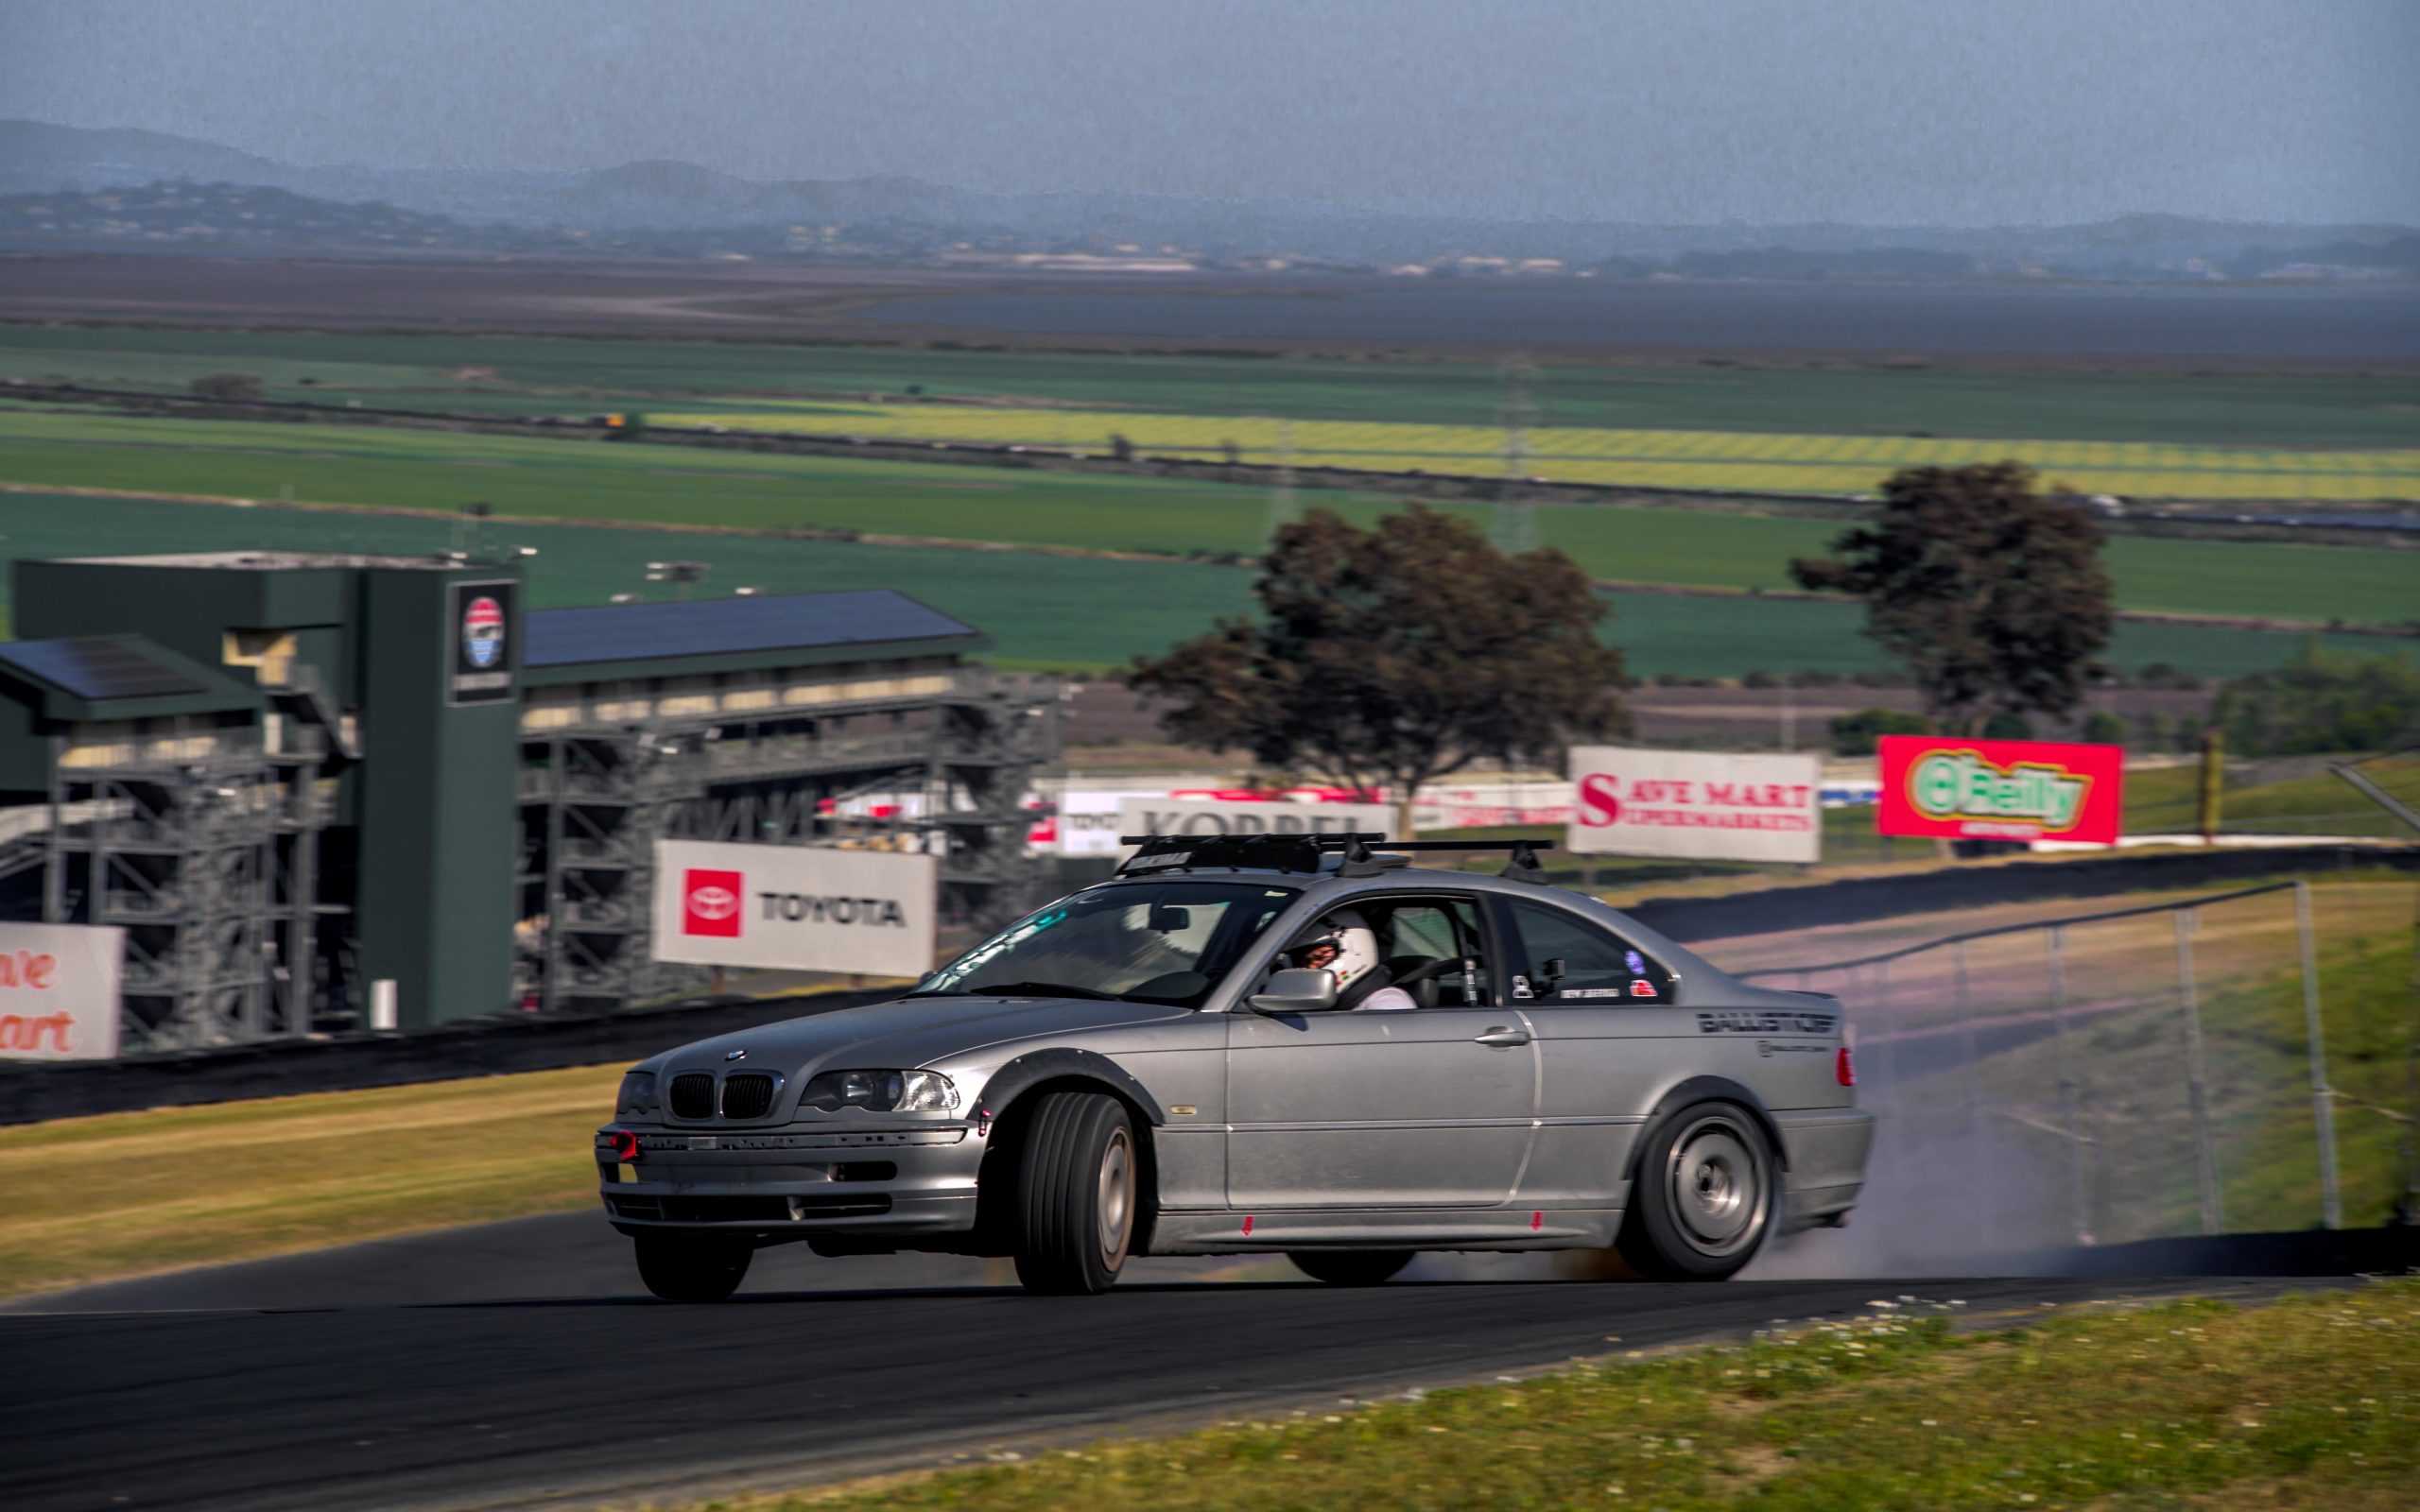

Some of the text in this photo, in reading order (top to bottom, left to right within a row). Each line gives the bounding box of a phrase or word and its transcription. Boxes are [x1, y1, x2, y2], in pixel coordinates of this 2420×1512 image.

[1580, 772, 1693, 828] SAVE
[1703, 782, 1811, 809] MART
[1910, 755, 2087, 826] O'Reilly
[756, 892, 908, 928] TOYOTA
